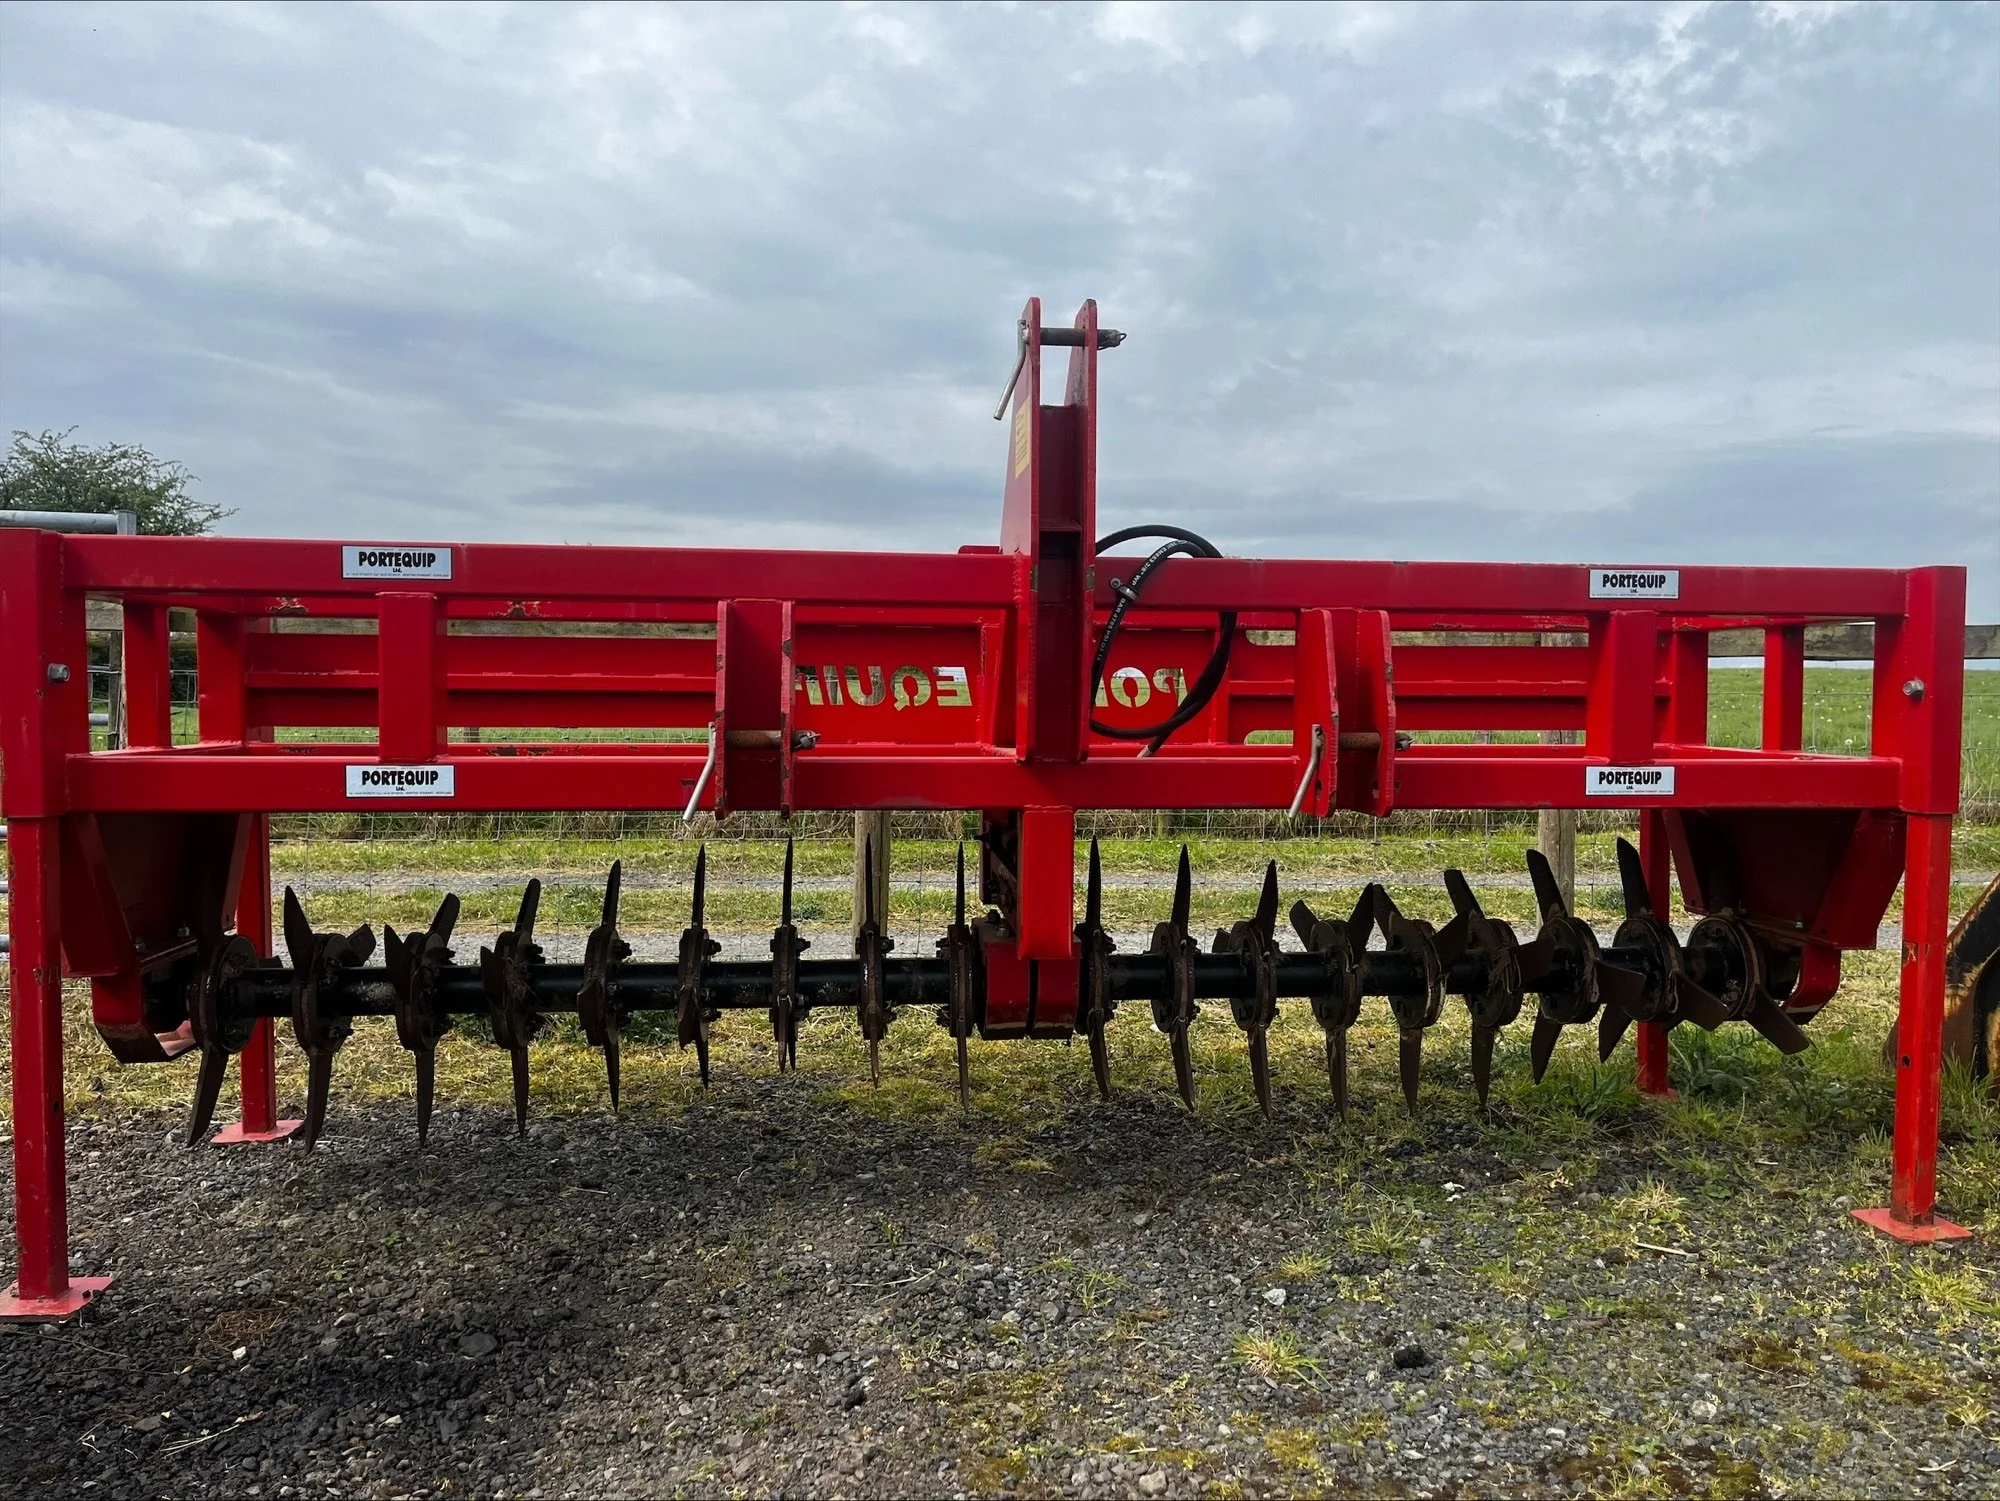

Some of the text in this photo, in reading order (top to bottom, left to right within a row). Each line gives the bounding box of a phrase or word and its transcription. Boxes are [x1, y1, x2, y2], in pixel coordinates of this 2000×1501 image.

[358, 551, 436, 568] PORTEQUIP
[1602, 574, 1666, 588] PORTEQUIP
[361, 770, 439, 786] PORTEQUIP
[1598, 771, 1662, 785] PORTEQUIP
